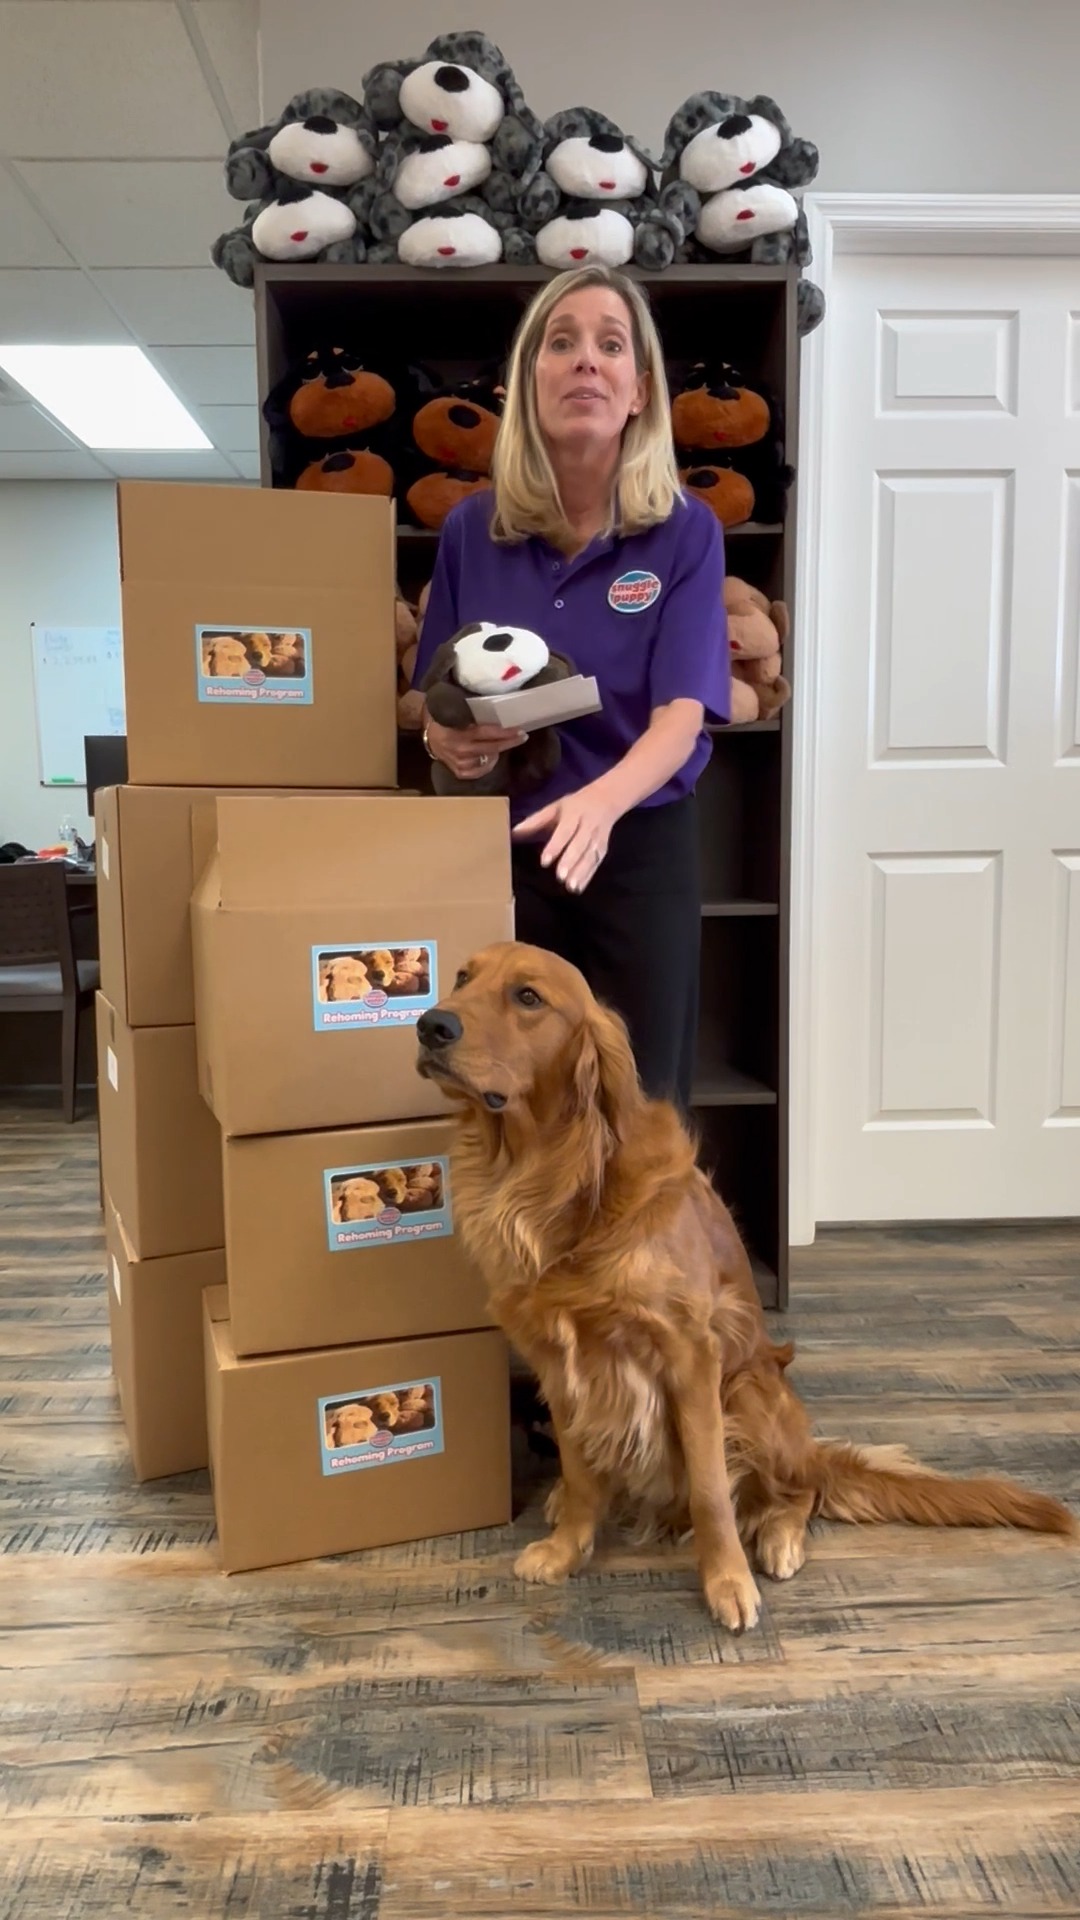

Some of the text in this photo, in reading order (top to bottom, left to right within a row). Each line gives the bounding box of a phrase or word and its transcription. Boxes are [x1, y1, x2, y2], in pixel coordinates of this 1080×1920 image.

[612, 579, 659, 592] snuggle
[613, 592, 651, 604] puppy
[206, 687, 304, 700] Rehoming Program
[323, 1010, 378, 1024] Rehoming
[337, 1222, 443, 1243] Rehoming Program
[331, 1441, 434, 1467] Rehoming Program
